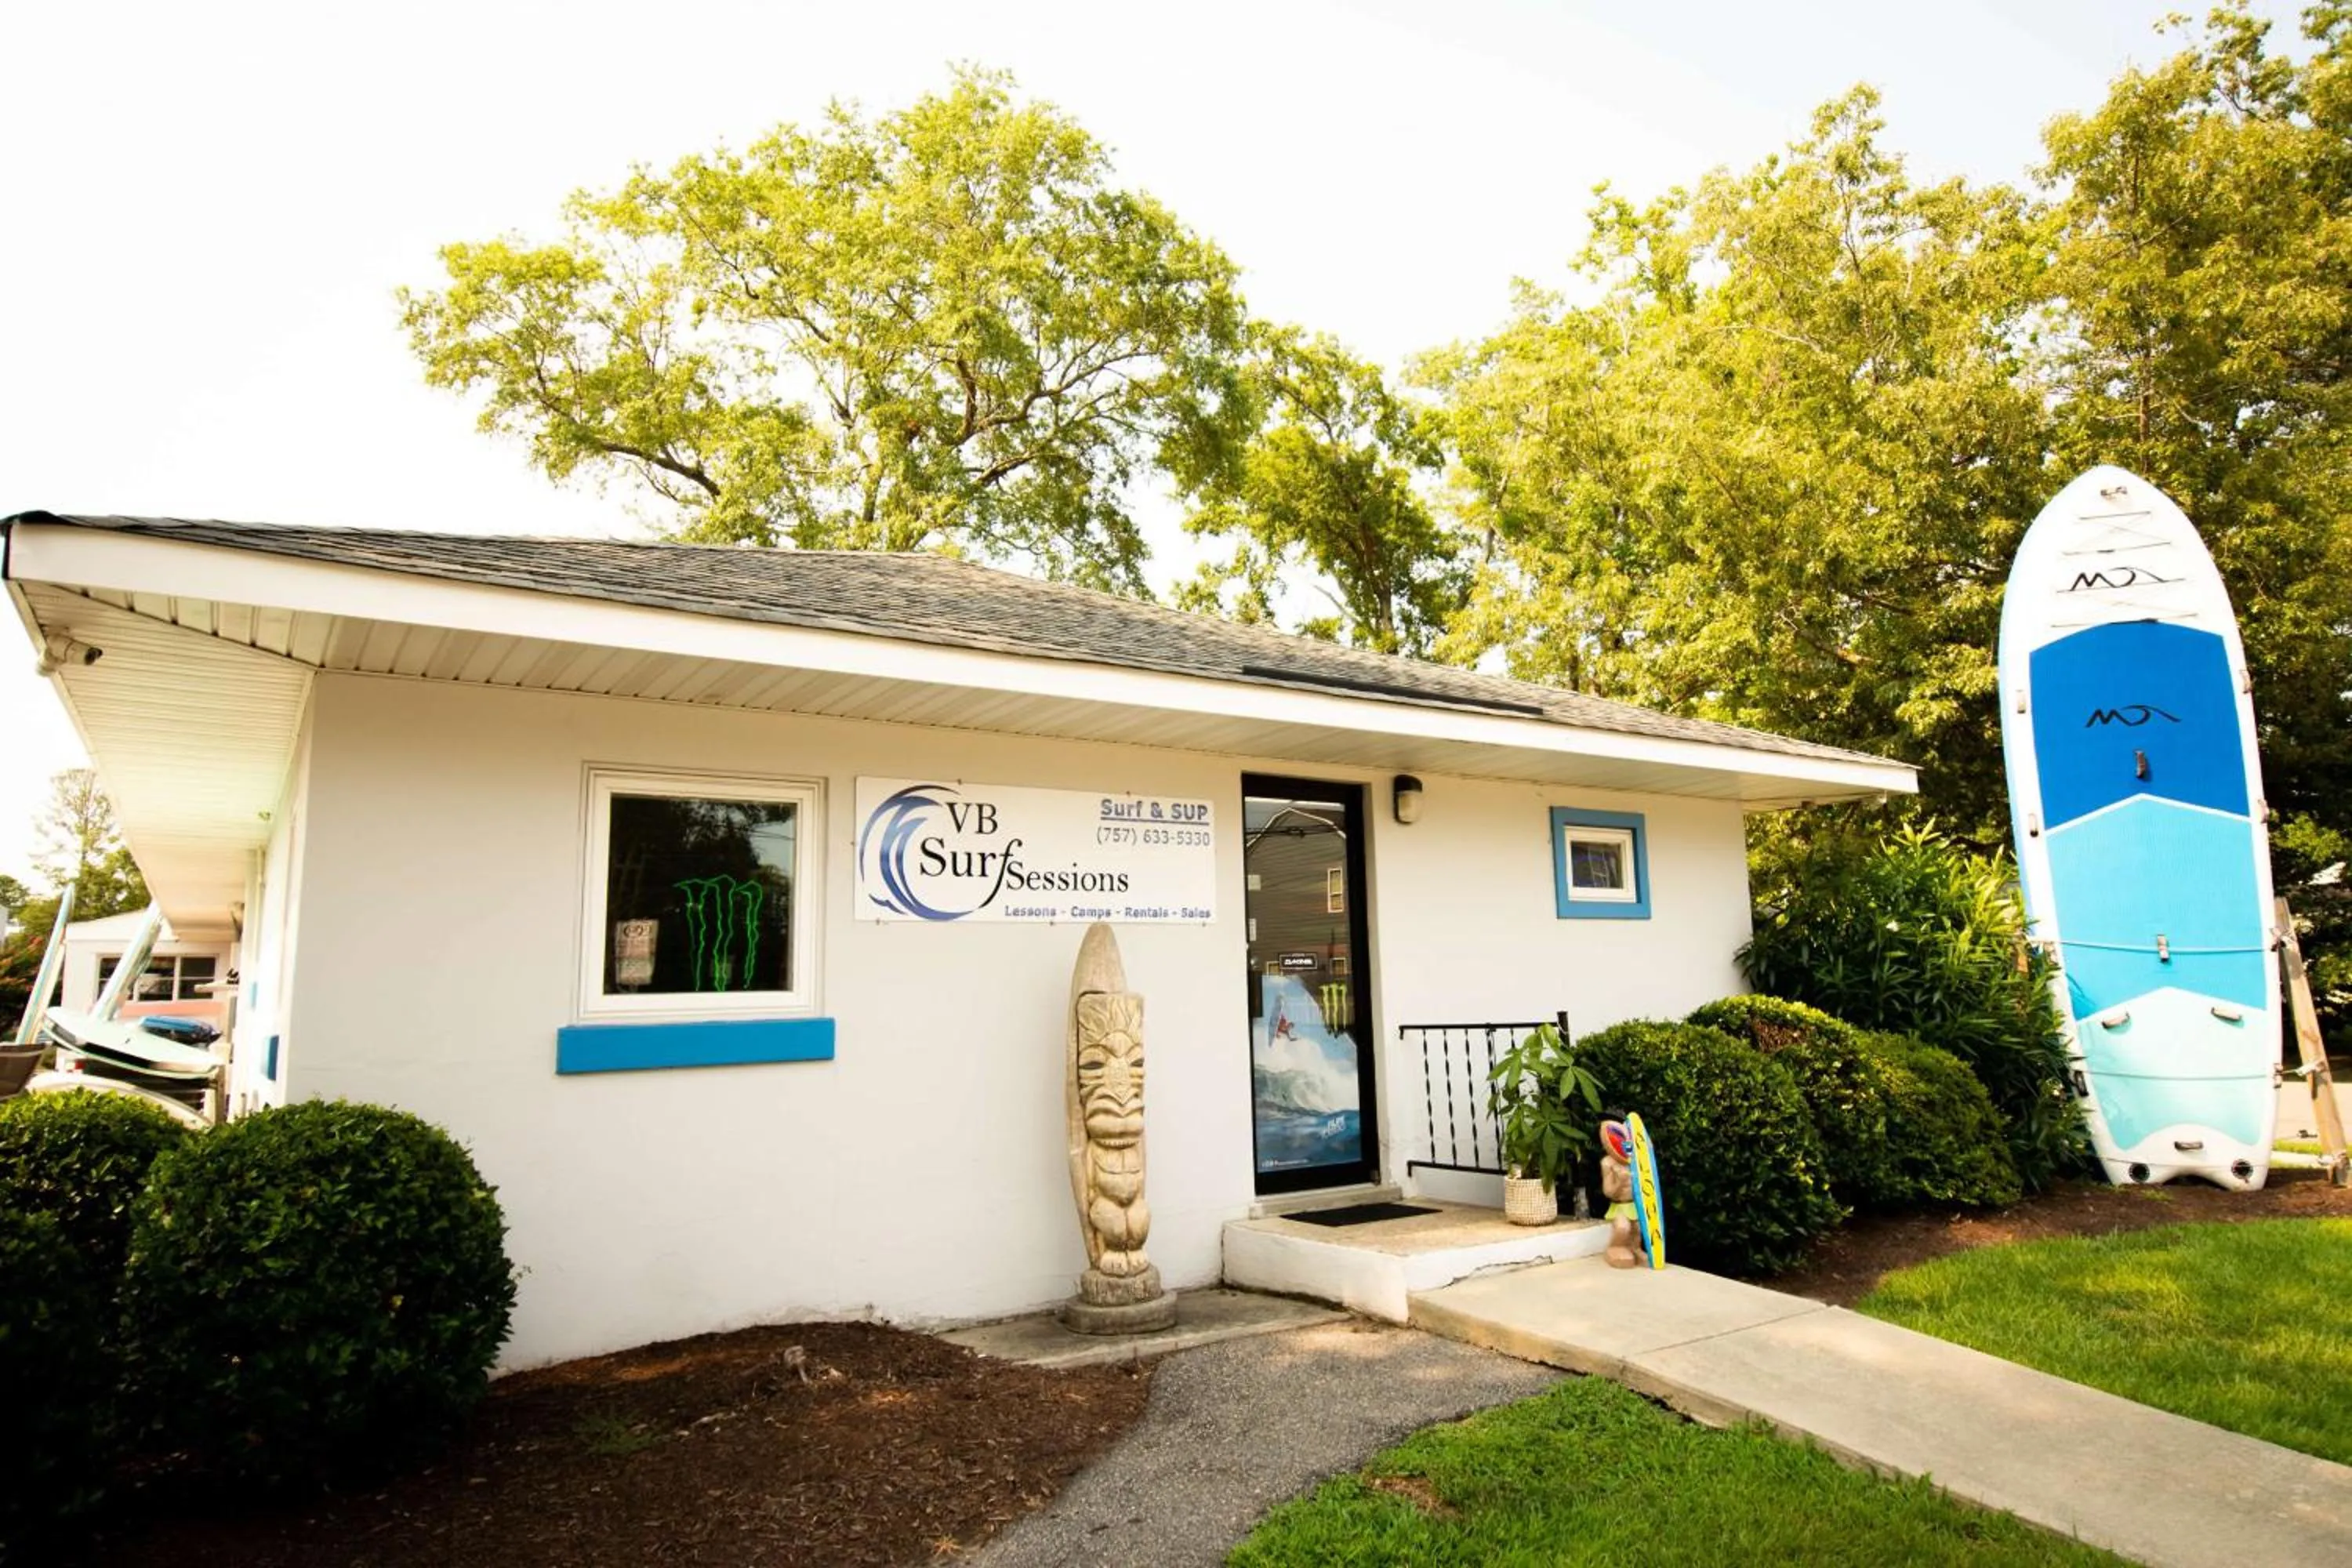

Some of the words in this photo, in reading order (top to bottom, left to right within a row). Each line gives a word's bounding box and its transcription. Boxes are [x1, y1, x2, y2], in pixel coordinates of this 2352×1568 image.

[946, 802, 998, 835] VB
[1101, 799, 1142, 818] Surf
[1150, 802, 1163, 818] &
[1171, 804, 1208, 821] SUP
[1097, 826, 1137, 845] (757)
[1143, 829, 1210, 847] 633-5330
[920, 837, 1023, 908] Surf
[1006, 861, 1129, 892] Sessions
[1004, 905, 1057, 917] Lessons
[1070, 906, 1112, 920] Camps
[1124, 907, 1169, 918] Rentals
[1181, 907, 1211, 918] Sales
